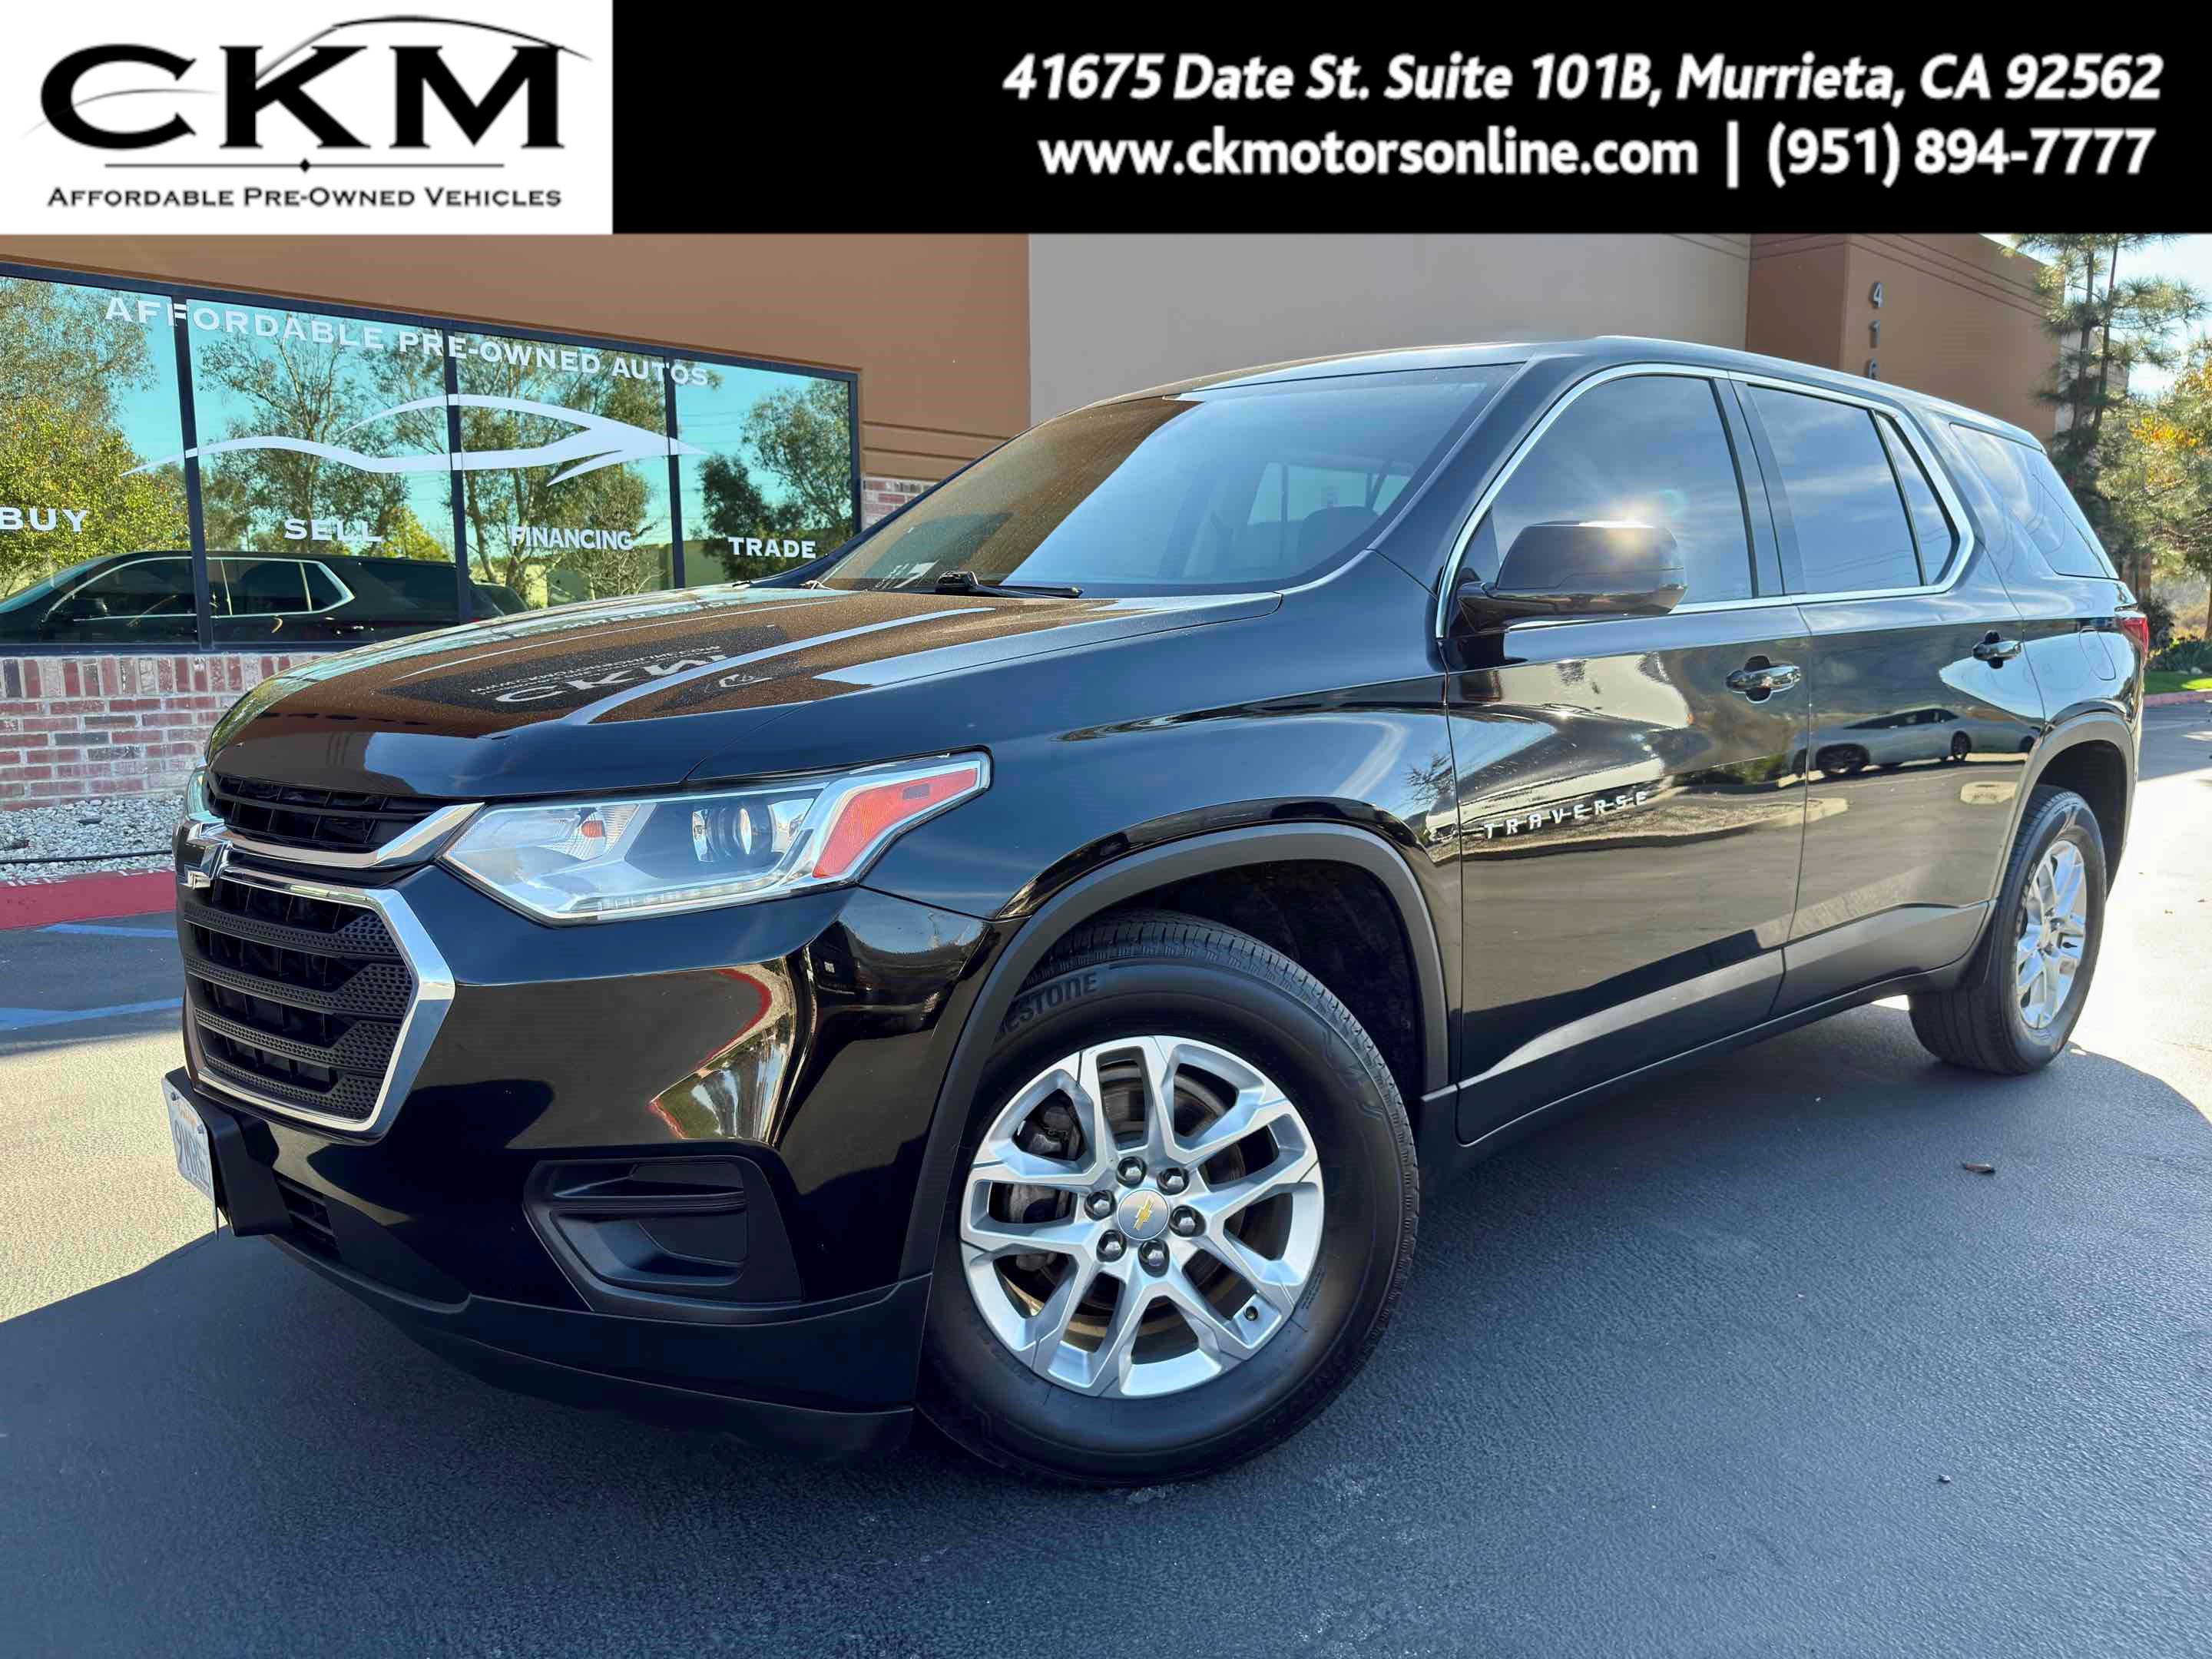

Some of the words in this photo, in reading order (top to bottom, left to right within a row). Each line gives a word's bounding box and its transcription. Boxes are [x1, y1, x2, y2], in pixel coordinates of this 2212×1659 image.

[105, 296, 383, 349] AFFORDABLE
[398, 330, 601, 375] PRE-OWNED
[611, 357, 709, 386] AUTOS
[0, 506, 87, 532] BUY
[283, 518, 382, 542] SELL
[510, 526, 634, 551] FINANCING
[728, 537, 816, 559] TRADE
[1483, 790, 1651, 839] TRAVERSE
